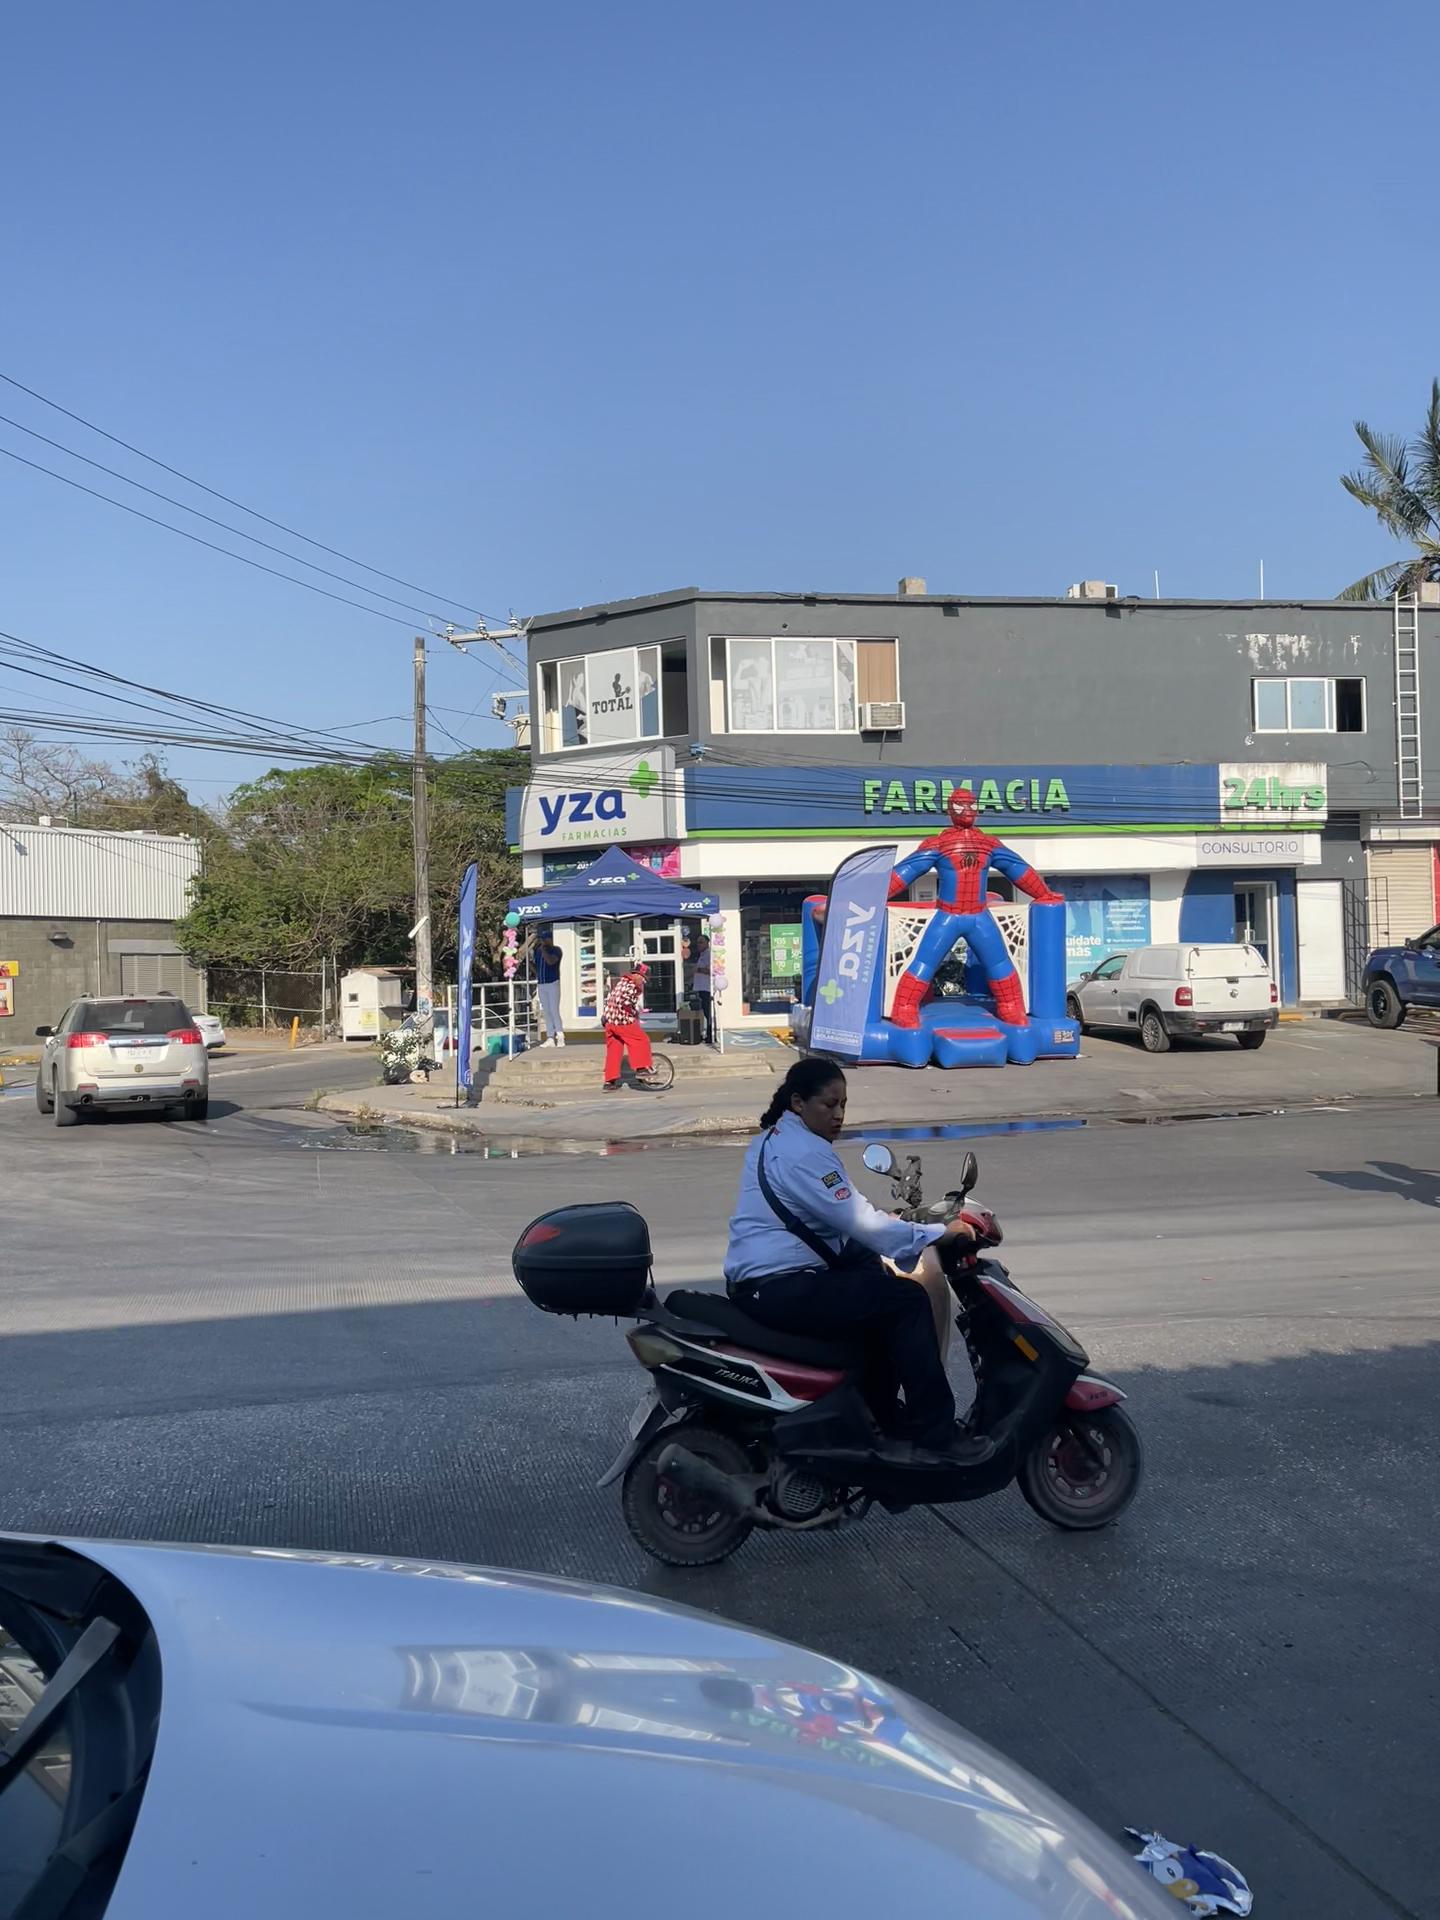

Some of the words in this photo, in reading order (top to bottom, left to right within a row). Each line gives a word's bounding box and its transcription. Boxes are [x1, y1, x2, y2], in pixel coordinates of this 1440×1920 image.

[592, 697, 633, 714] TOTAL
[1223, 776, 1326, 810] 24hrs
[538, 788, 626, 836] yza
[561, 826, 628, 841] FARMACIAS
[1202, 841, 1298, 854] CONSULTORIO
[587, 875, 627, 886] yza
[517, 904, 542, 915] yza
[679, 900, 703, 911] yza
[715, 1368, 758, 1387] ITALIKA
